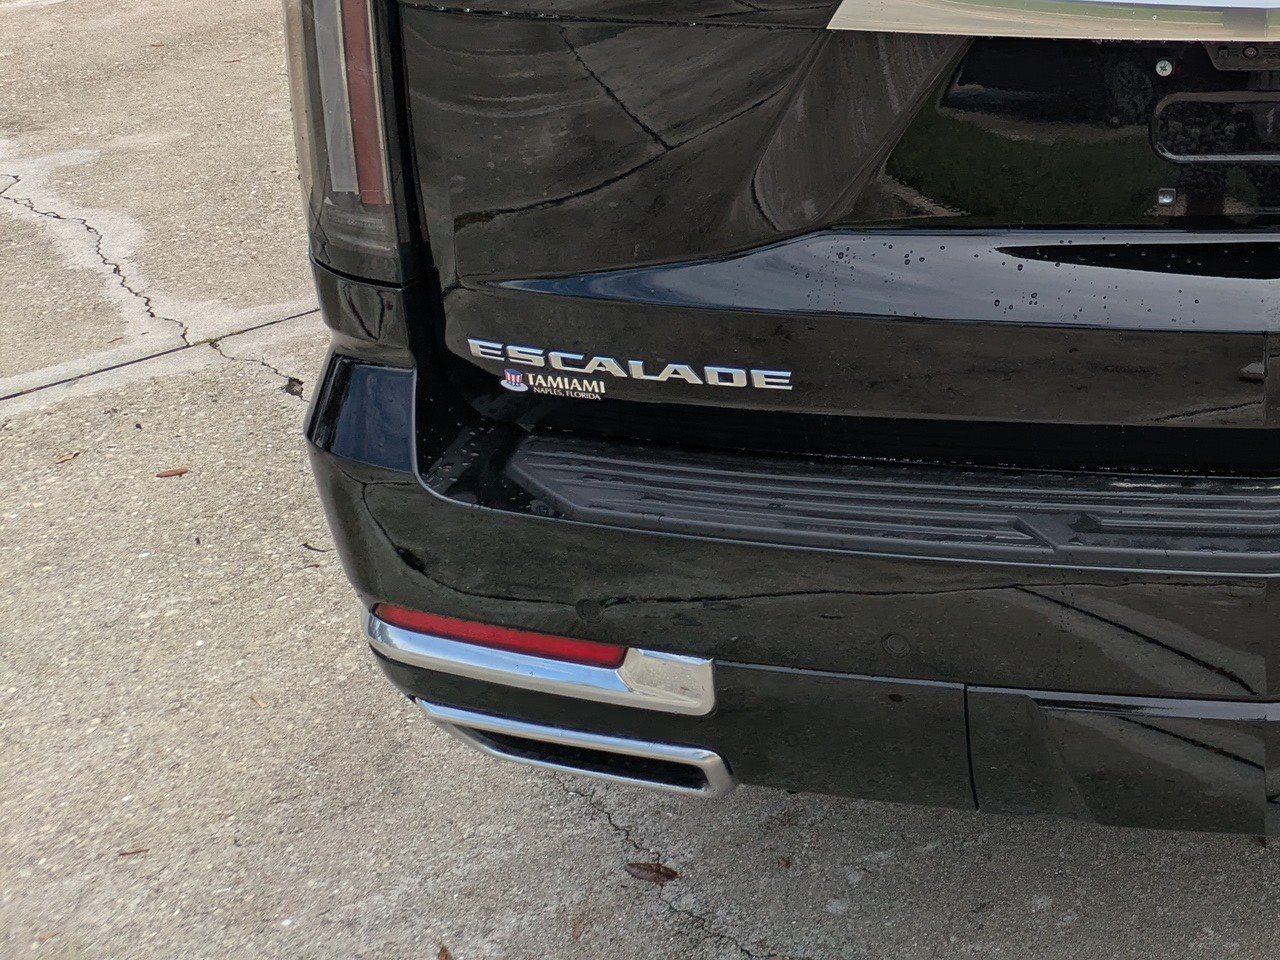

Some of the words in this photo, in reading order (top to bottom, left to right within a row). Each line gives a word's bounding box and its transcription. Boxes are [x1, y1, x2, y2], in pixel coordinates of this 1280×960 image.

[467, 338, 793, 390] ESCALADE
[525, 372, 606, 394] TAMIAMI
[533, 386, 565, 397] NAPLES,
[566, 390, 601, 400] FLORIDA
